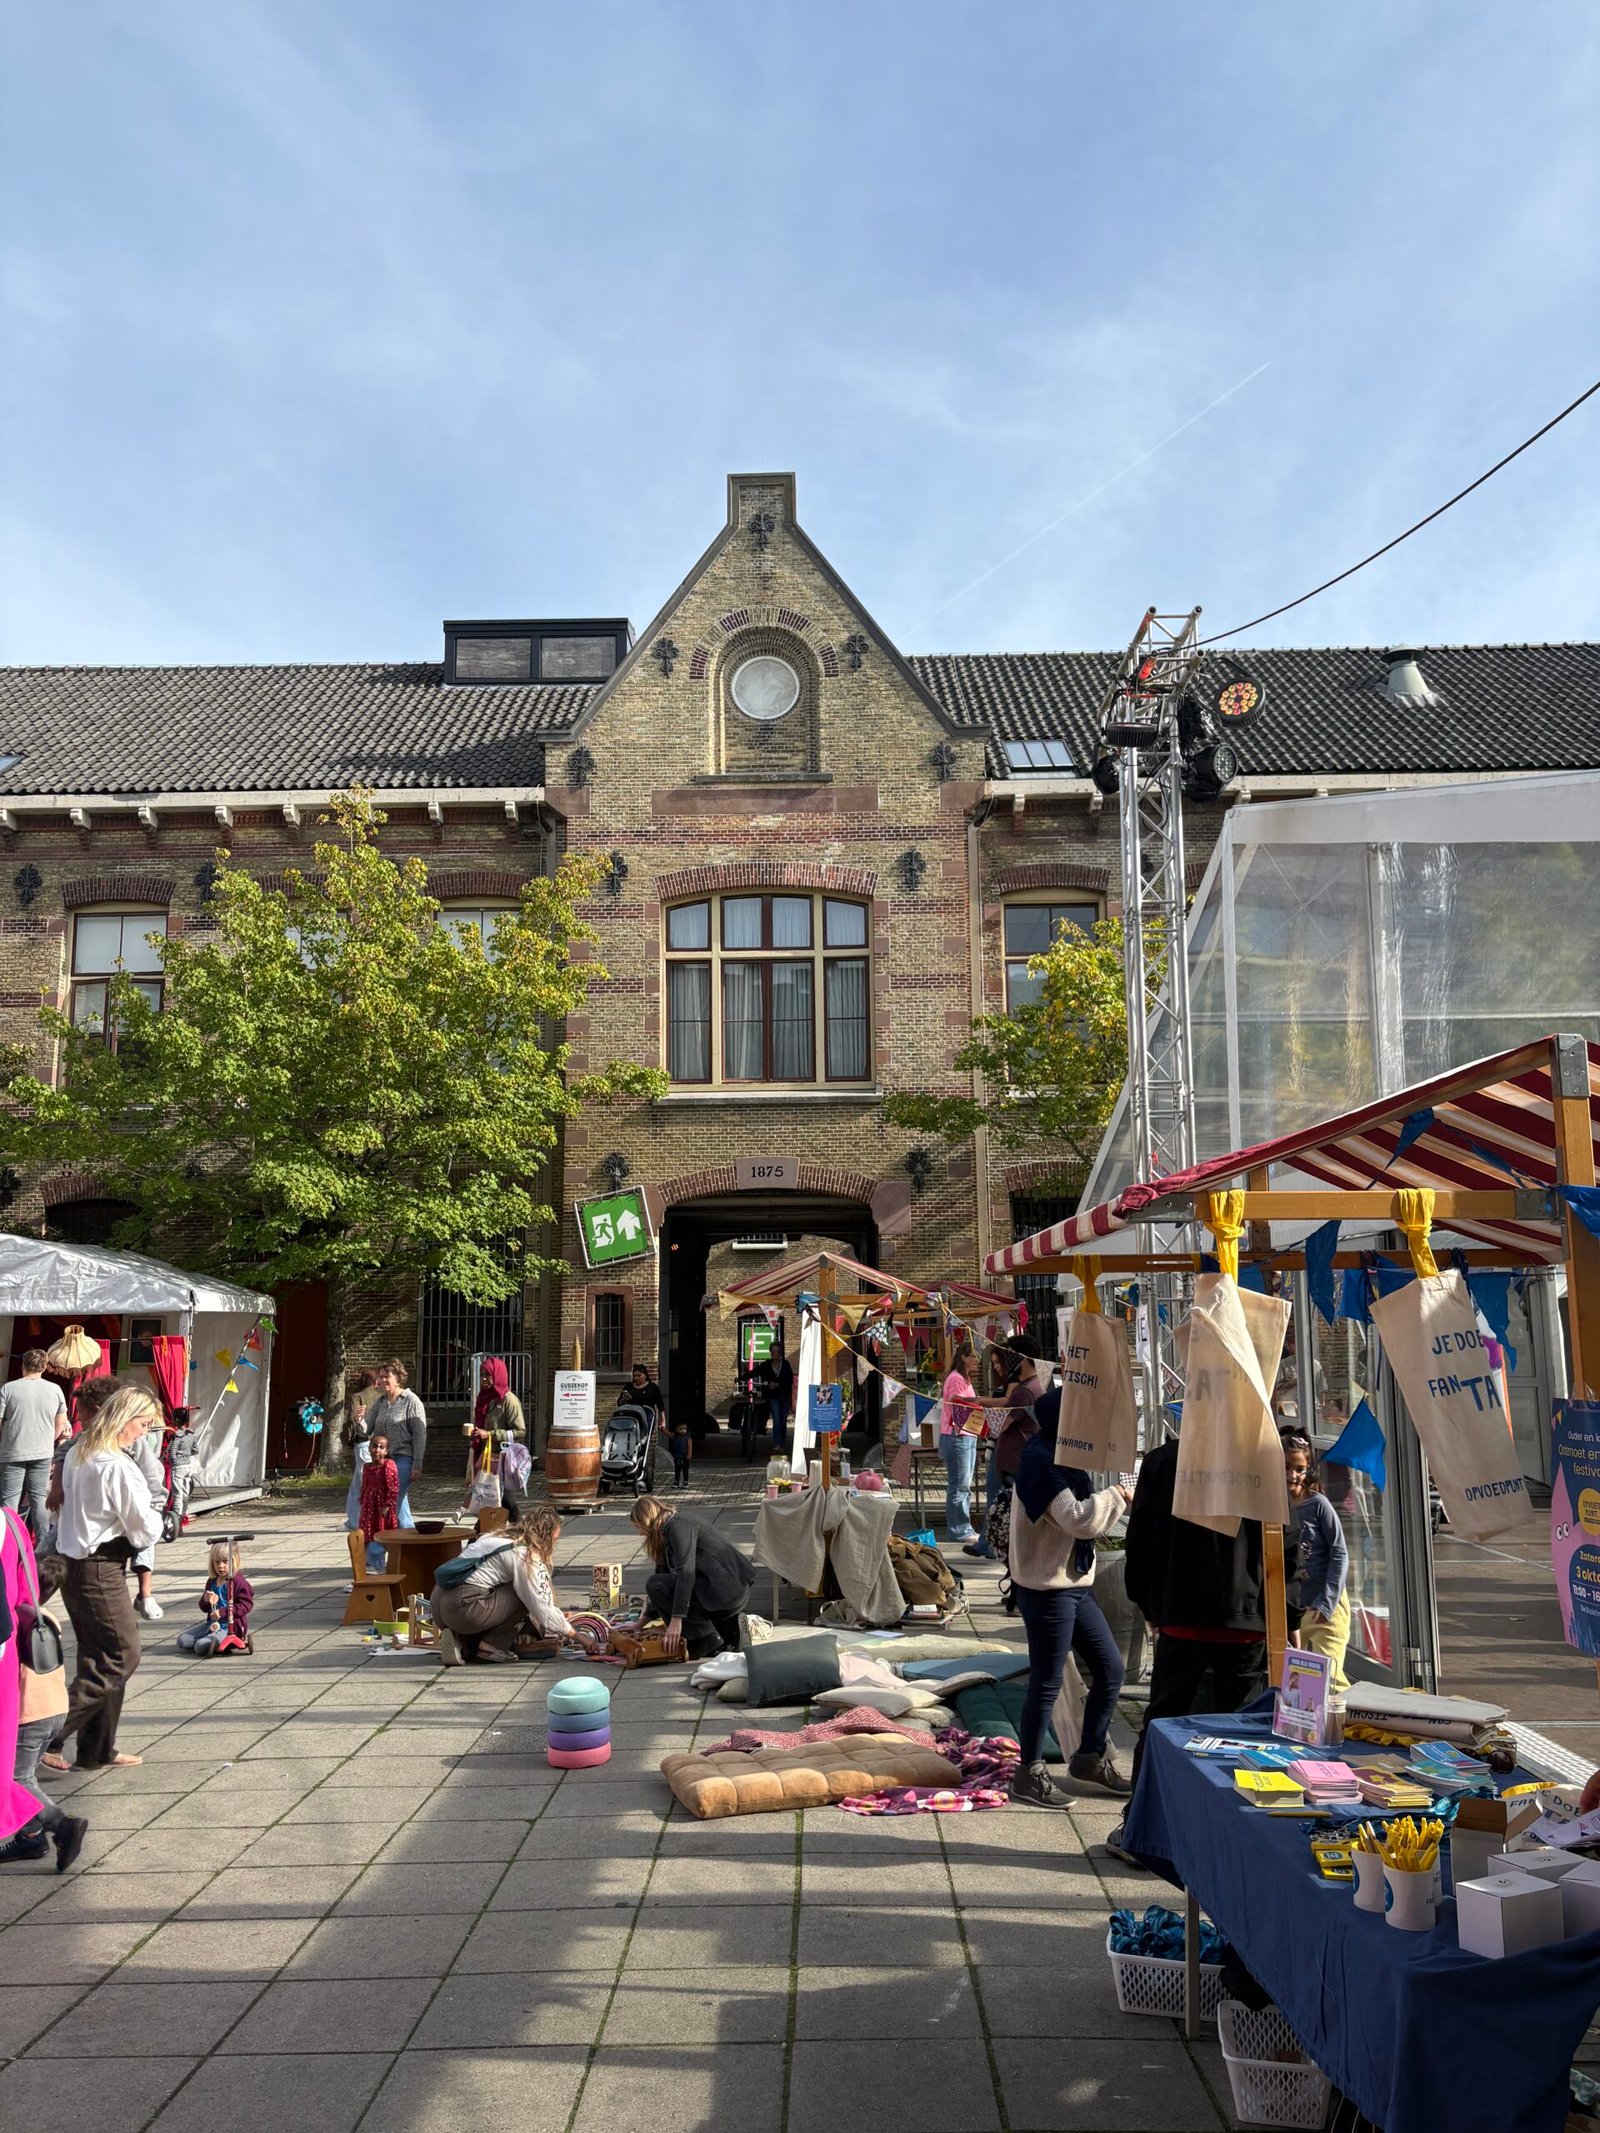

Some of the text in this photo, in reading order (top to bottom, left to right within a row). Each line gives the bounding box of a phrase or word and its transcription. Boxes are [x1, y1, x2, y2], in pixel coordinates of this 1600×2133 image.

[751, 1165, 784, 1178] 1875
[1432, 1329, 1485, 1355] JE DOE
[1067, 1345, 1090, 1360] HET
[1583, 1434, 1594, 1442] en
[1558, 1444, 1586, 1459] Ontmoet
[1464, 1478, 1524, 1501] OPVOEDPUNT
[1576, 1565, 1581, 1578] 3
